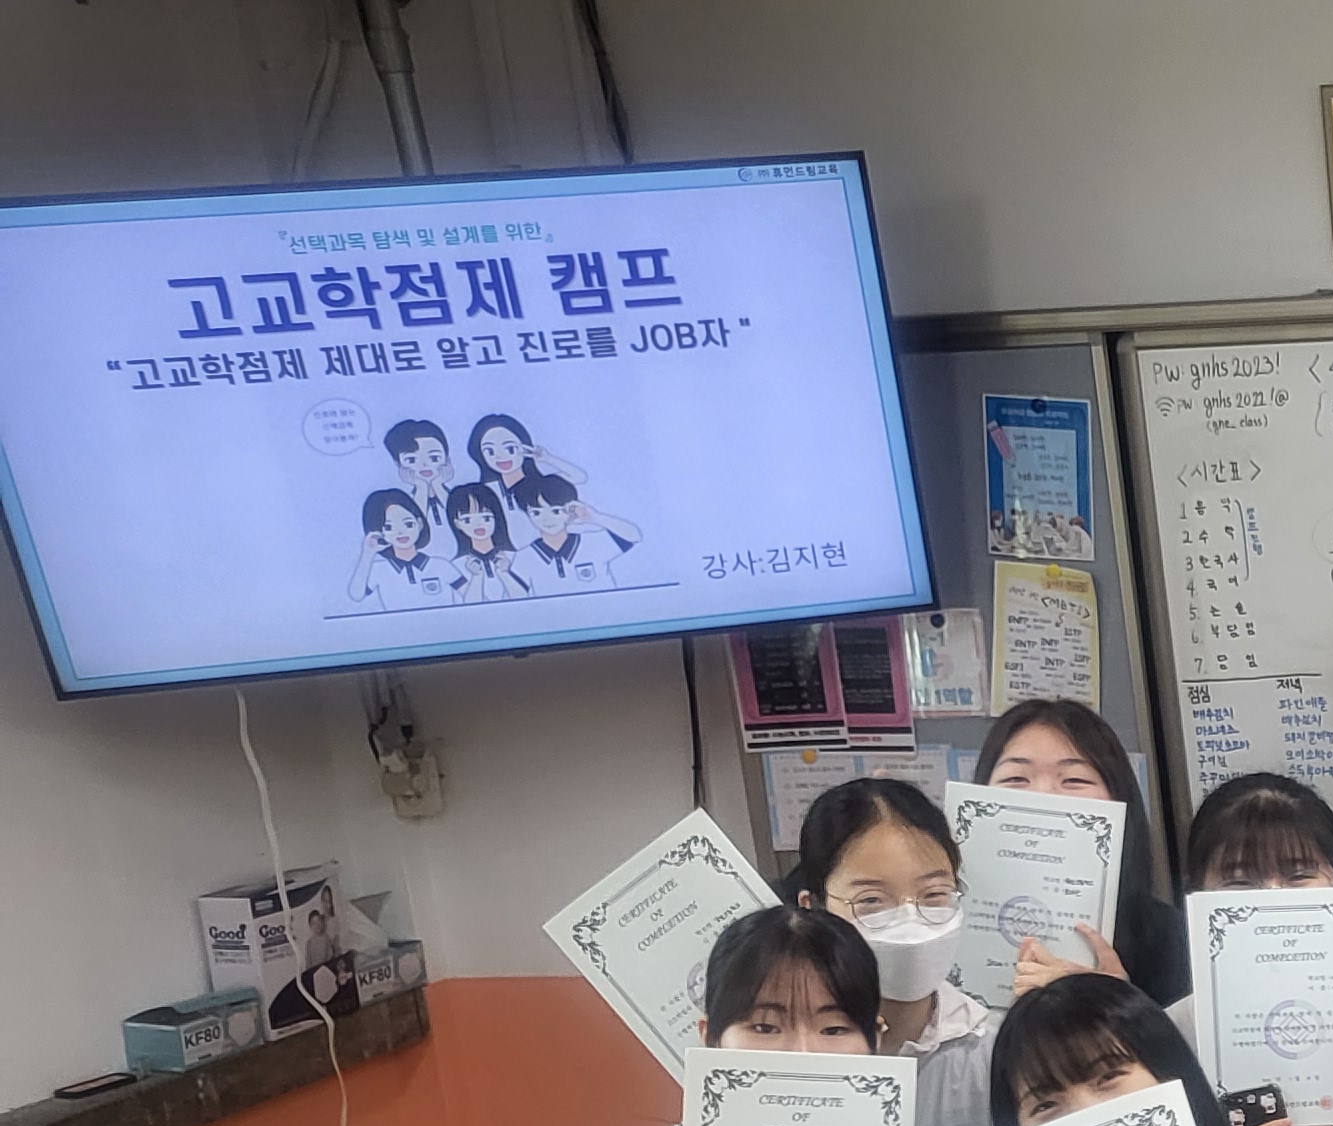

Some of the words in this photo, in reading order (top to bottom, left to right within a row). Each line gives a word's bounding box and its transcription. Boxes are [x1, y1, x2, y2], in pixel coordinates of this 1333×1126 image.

[372, 229, 411, 250] 탐색
[417, 227, 435, 247] 및
[442, 224, 498, 245] 설계를
[167, 257, 523, 339] 고교학점제
[546, 248, 683, 316] 캠프
[325, 339, 426, 376] 제대로
[437, 334, 512, 369] 알고
[519, 326, 618, 363] 진로를
[1276, 678, 1303, 693] 저녁
[1187, 684, 1211, 705] 점심
[209, 924, 248, 941] Good
[259, 924, 290, 938] Goo
[1254, 924, 1325, 935] CERTIFICATE
[1282, 939, 1298, 948] OF
[1255, 952, 1327, 964] COMPLETION
[358, 965, 391, 988] KF80
[184, 1025, 221, 1050] KF80
[758, 1095, 844, 1108] CERTIFICATE
[791, 1112, 810, 1122] OF
